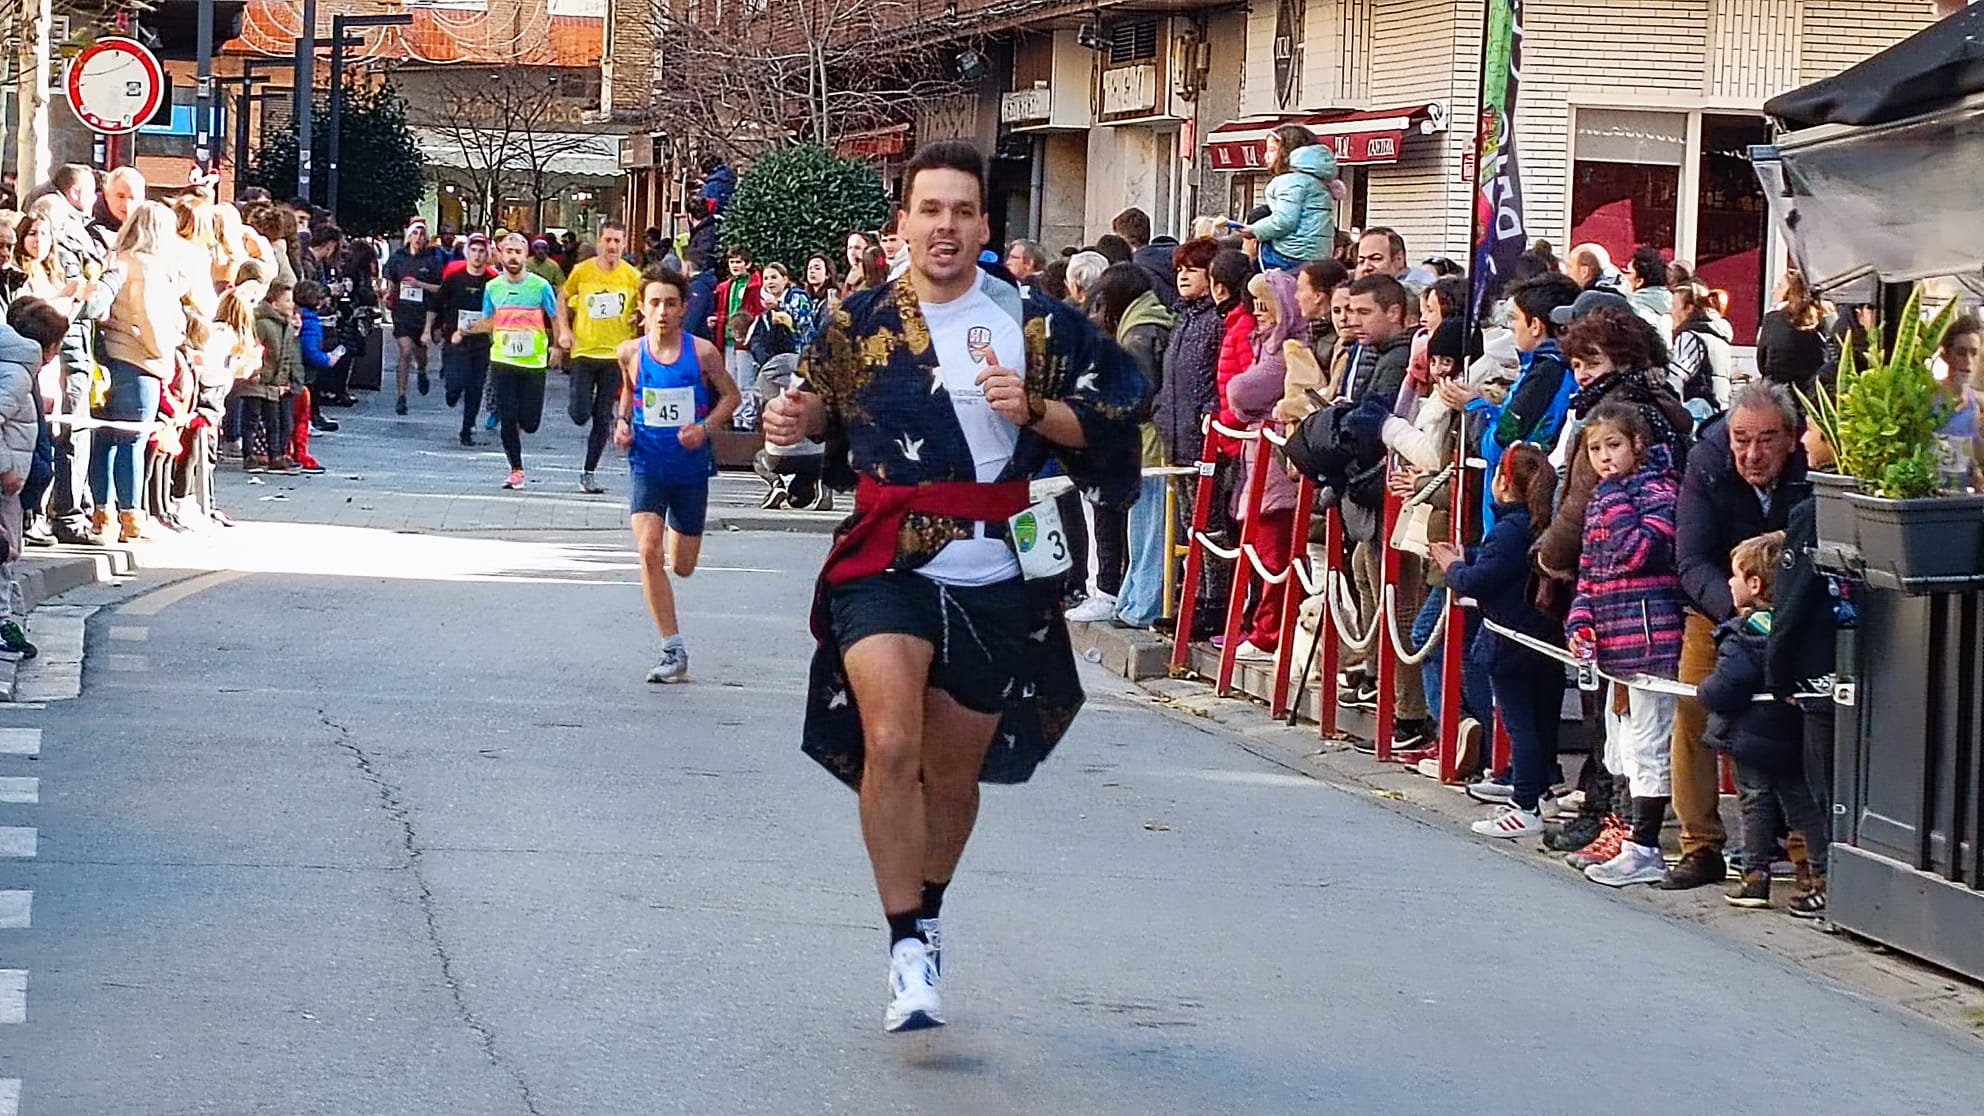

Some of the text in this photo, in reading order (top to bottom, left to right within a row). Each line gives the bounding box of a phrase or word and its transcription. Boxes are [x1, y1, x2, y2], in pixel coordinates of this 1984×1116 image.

[512, 343, 524, 353] 10
[659, 404, 679, 421] 45
[1047, 530, 1065, 561] 3
